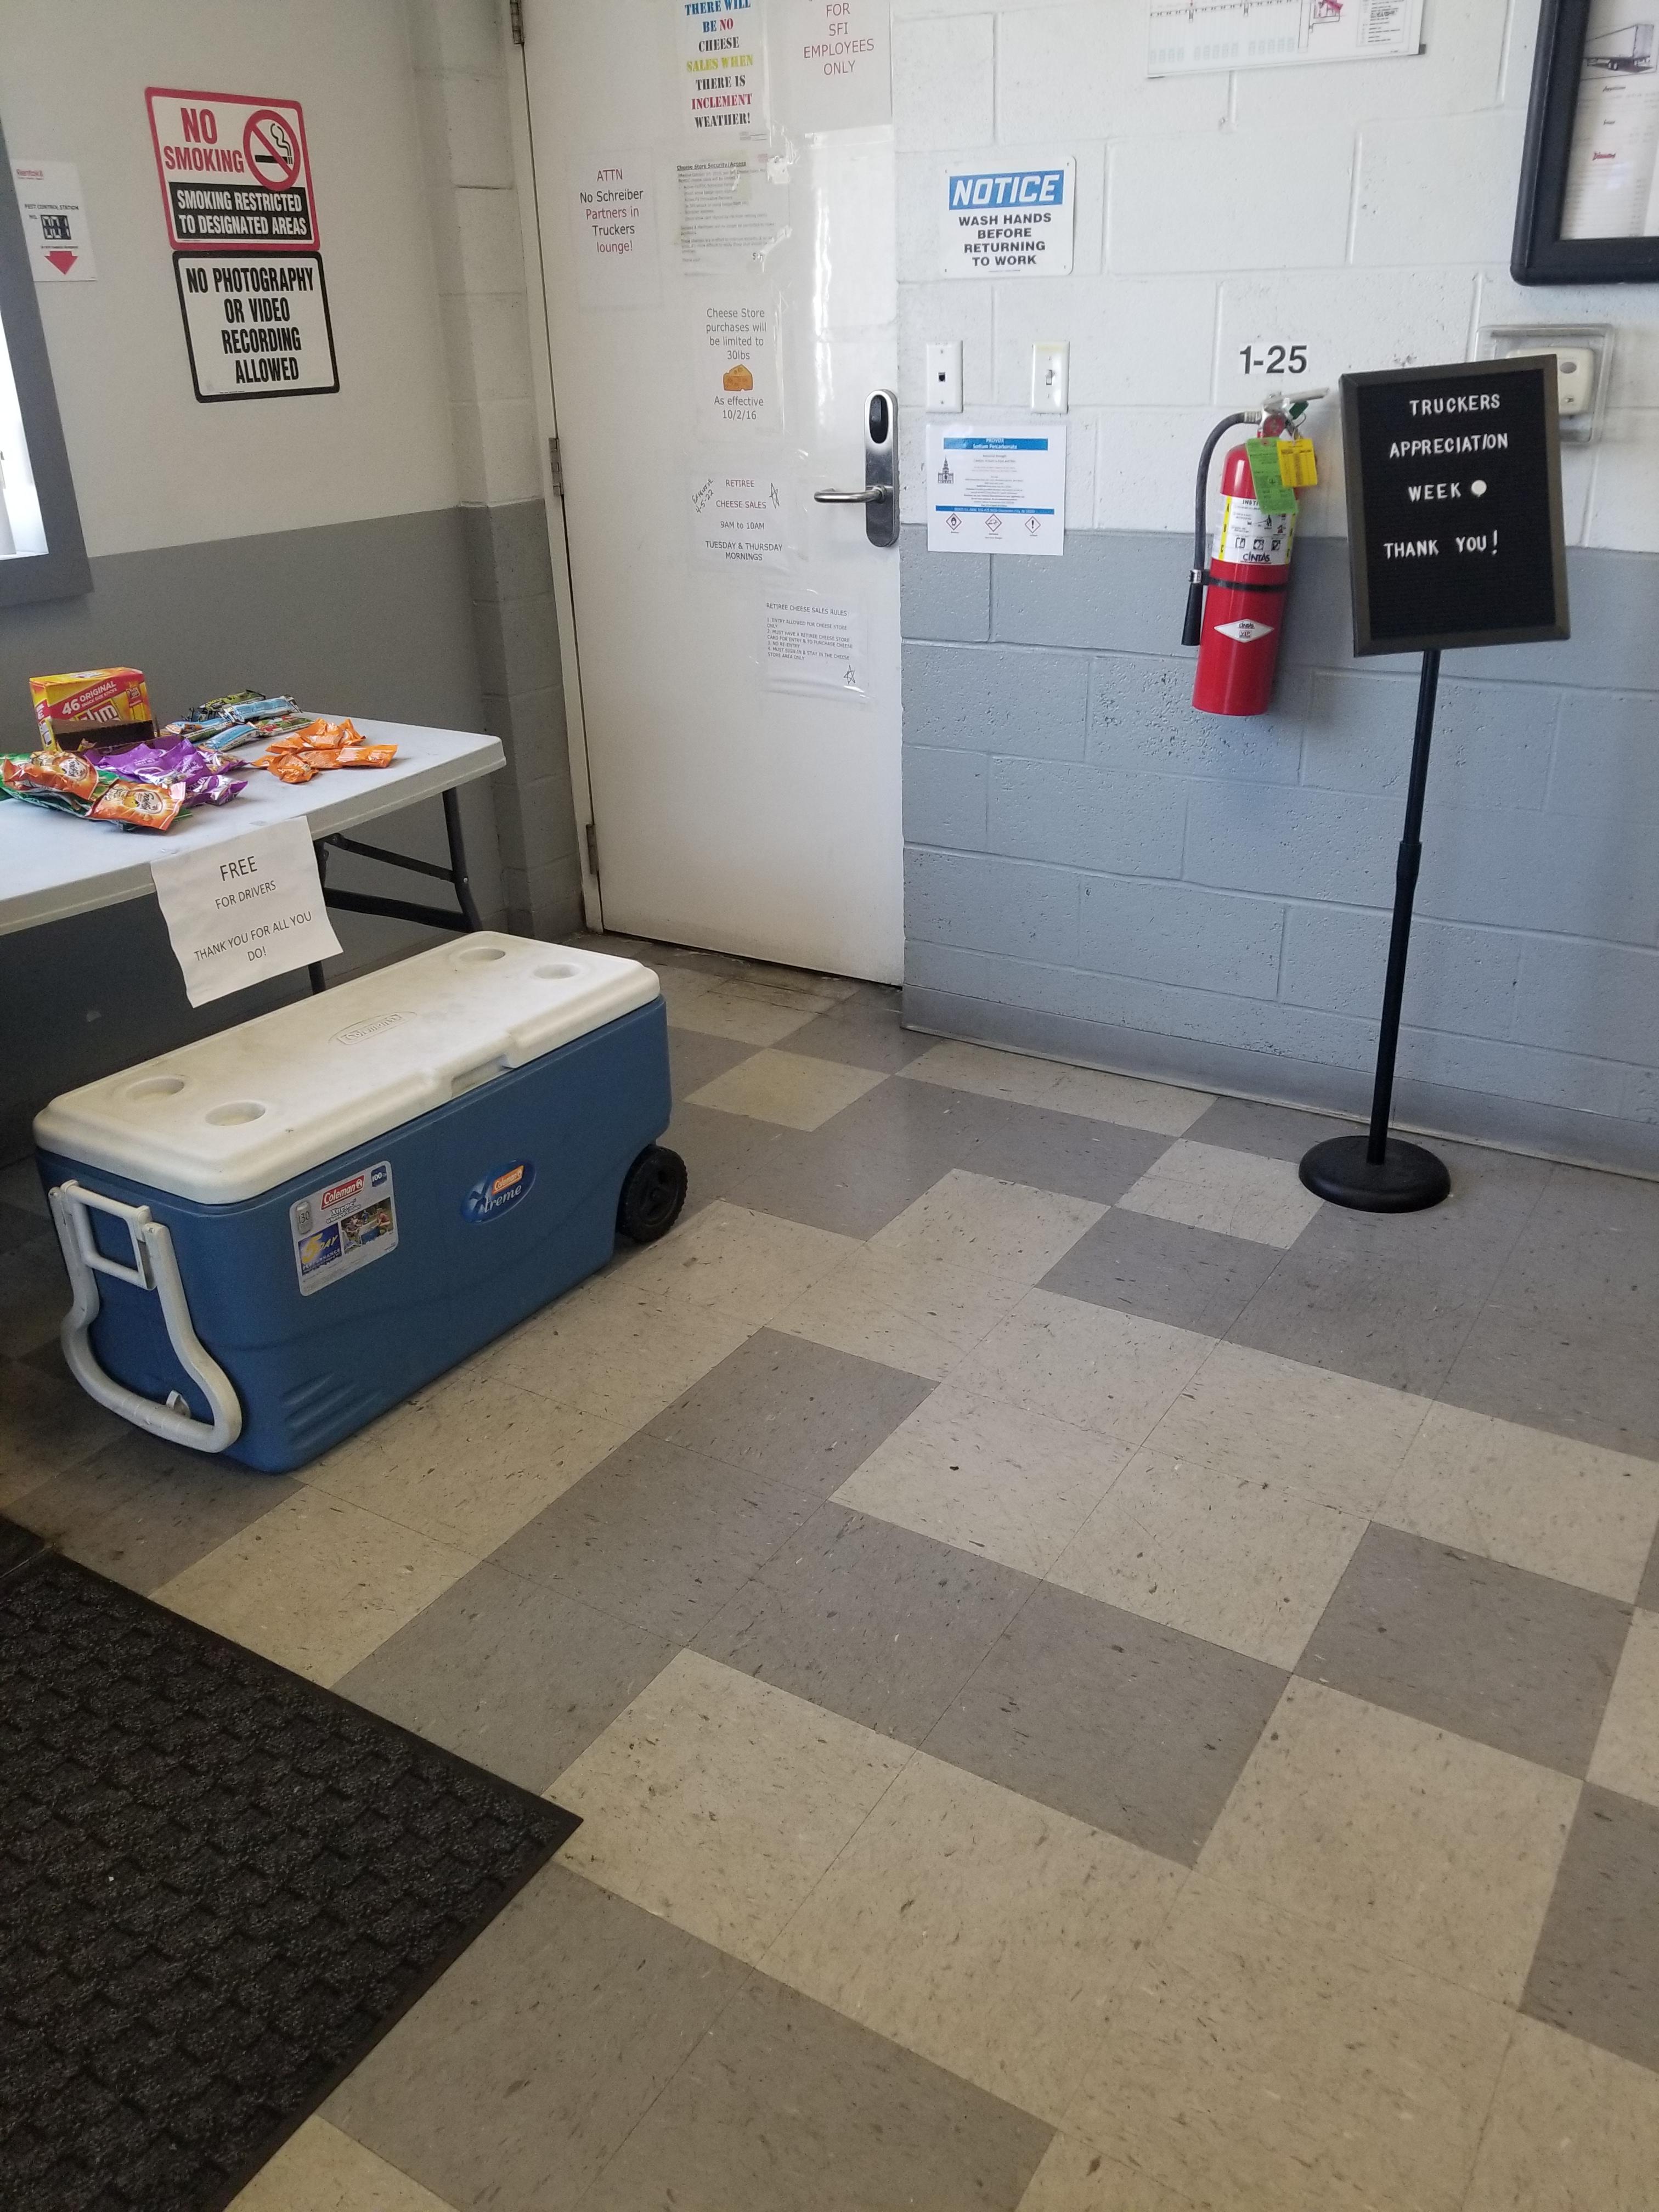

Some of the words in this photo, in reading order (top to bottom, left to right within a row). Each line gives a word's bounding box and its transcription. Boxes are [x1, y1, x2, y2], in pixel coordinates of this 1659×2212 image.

[685, 1, 722, 15] THERE
[724, 0, 751, 10] WILL
[826, 3, 850, 18] FOR
[703, 20, 717, 32] BE
[720, 18, 733, 31] NO
[829, 22, 848, 36] SFI
[698, 36, 740, 52] CHEESE
[804, 38, 874, 59] EMPLOYEES
[687, 58, 718, 71] SALES
[721, 55, 753, 69] WHEN
[824, 60, 855, 75] ONLY
[695, 76, 732, 91] THERE
[735, 75, 746, 87] IS
[691, 93, 752, 110] INCLEMENT
[180, 108, 217, 144] NO
[695, 112, 751, 128] WEATHER!
[163, 145, 245, 173] SMOKING
[597, 168, 623, 182] ATTN
[580, 191, 593, 204] No
[596, 188, 644, 202] Schreiber
[952, 174, 1060, 206] NOTICE
[177, 190, 232, 211] SMOKING
[234, 192, 302, 212] RESTRICTED
[586, 208, 627, 220] Partners
[630, 206, 639, 217] in
[958, 215, 998, 226] WASH
[1003, 212, 1052, 224] HANDS
[178, 215, 196, 234] TO
[197, 215, 269, 235] DESIGNATED
[272, 217, 307, 235] AREAS
[592, 223, 635, 236] Truckers
[978, 228, 1032, 239] BEFORE
[597, 240, 633, 255] lounge!
[964, 241, 1046, 253] RETURNING
[972, 257, 990, 267] TO
[995, 255, 1037, 266] WORK
[185, 267, 208, 294] NO
[212, 267, 313, 293] PHOTOGRAPHY
[224, 298, 245, 323] OR
[248, 297, 290, 323] VIDEO
[707, 308, 738, 318] Cheese
[741, 308, 765, 318] Store
[706, 322, 749, 334] purchases
[752, 323, 766, 332] will
[221, 326, 302, 354] RECORDING
[709, 336, 720, 346] be
[723, 336, 752, 346] limited
[755, 337, 764, 346] to
[727, 350, 750, 360] 30lbs
[1239, 345, 1308, 374] 1-25
[235, 357, 300, 384] ALLOWED
[714, 396, 724, 405] As
[727, 396, 764, 407] effective
[1409, 393, 1501, 416] TRUCKERS
[723, 410, 757, 421] 10/2/16
[1389, 432, 1509, 459] APPRECIATION
[725, 479, 755, 488] RETIREE
[1408, 482, 1462, 503] WEEK
[716, 500, 743, 508] CHEESE
[745, 501, 767, 509] SALES
[706, 540, 736, 549] TUESDAY
[745, 543, 783, 551] THURSDAY
[1383, 539, 1440, 560] THANK
[725, 552, 763, 561] MORNINGS
[790, 605, 810, 613] CHEESE
[61, 698, 81, 715] 46
[80, 680, 117, 702] ORIGINAL
[220, 856, 258, 882] FREE
[215, 895, 236, 910] FOR
[238, 881, 276, 902] DRIVERS
[194, 941, 227, 961] THANK
[228, 933, 249, 947] YOU
[251, 926, 270, 940] FOR
[273, 919, 290, 934] ALL
[290, 911, 312, 927] YOU
[247, 946, 267, 961] DO!
[324, 1183, 356, 1205] Coleman
[331, 1201, 354, 1215] Xtreme
